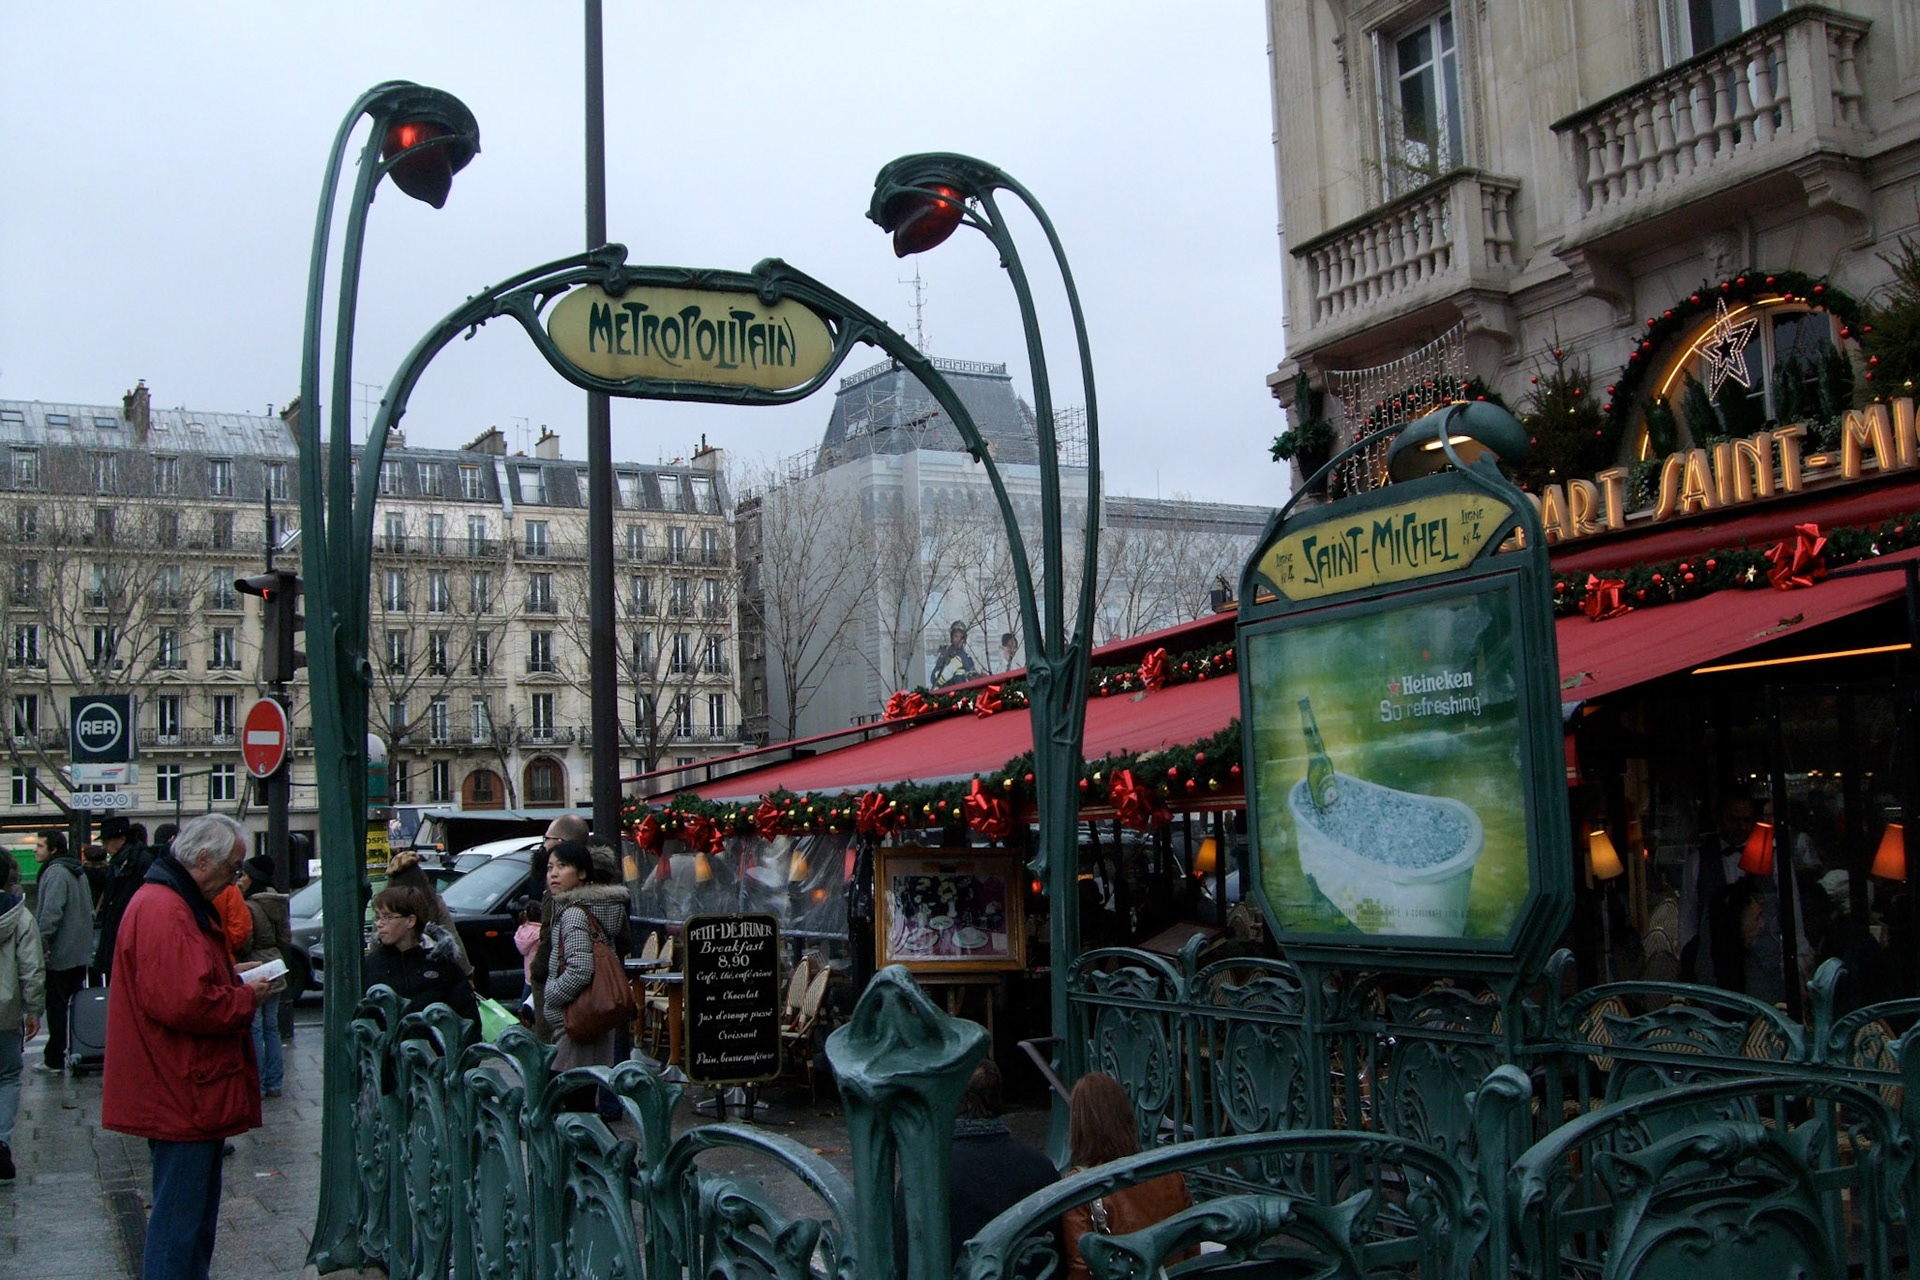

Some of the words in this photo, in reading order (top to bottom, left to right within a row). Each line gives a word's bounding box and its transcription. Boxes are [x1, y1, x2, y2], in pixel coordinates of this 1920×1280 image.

[588, 302, 796, 369] METROPOLITAIN
[1652, 397, 1920, 521] SAINT-MI
[1472, 522, 1481, 542] 4
[1302, 512, 1459, 588] SAINT-MICHEL
[1402, 670, 1473, 696] Heineken
[1380, 700, 1403, 722] So
[1407, 695, 1481, 717] refreshing
[80, 719, 117, 736] RER
[700, 940, 764, 956] Breakfast
[718, 954, 750, 969] 8,90
[722, 989, 760, 1000] Chocolat
[697, 1012, 713, 1027] Jus
[715, 1010, 749, 1022] d'orange
[749, 1008, 773, 1022] pressé
[718, 1029, 757, 1040] Croissant
[696, 1052, 719, 1065] Pain,
